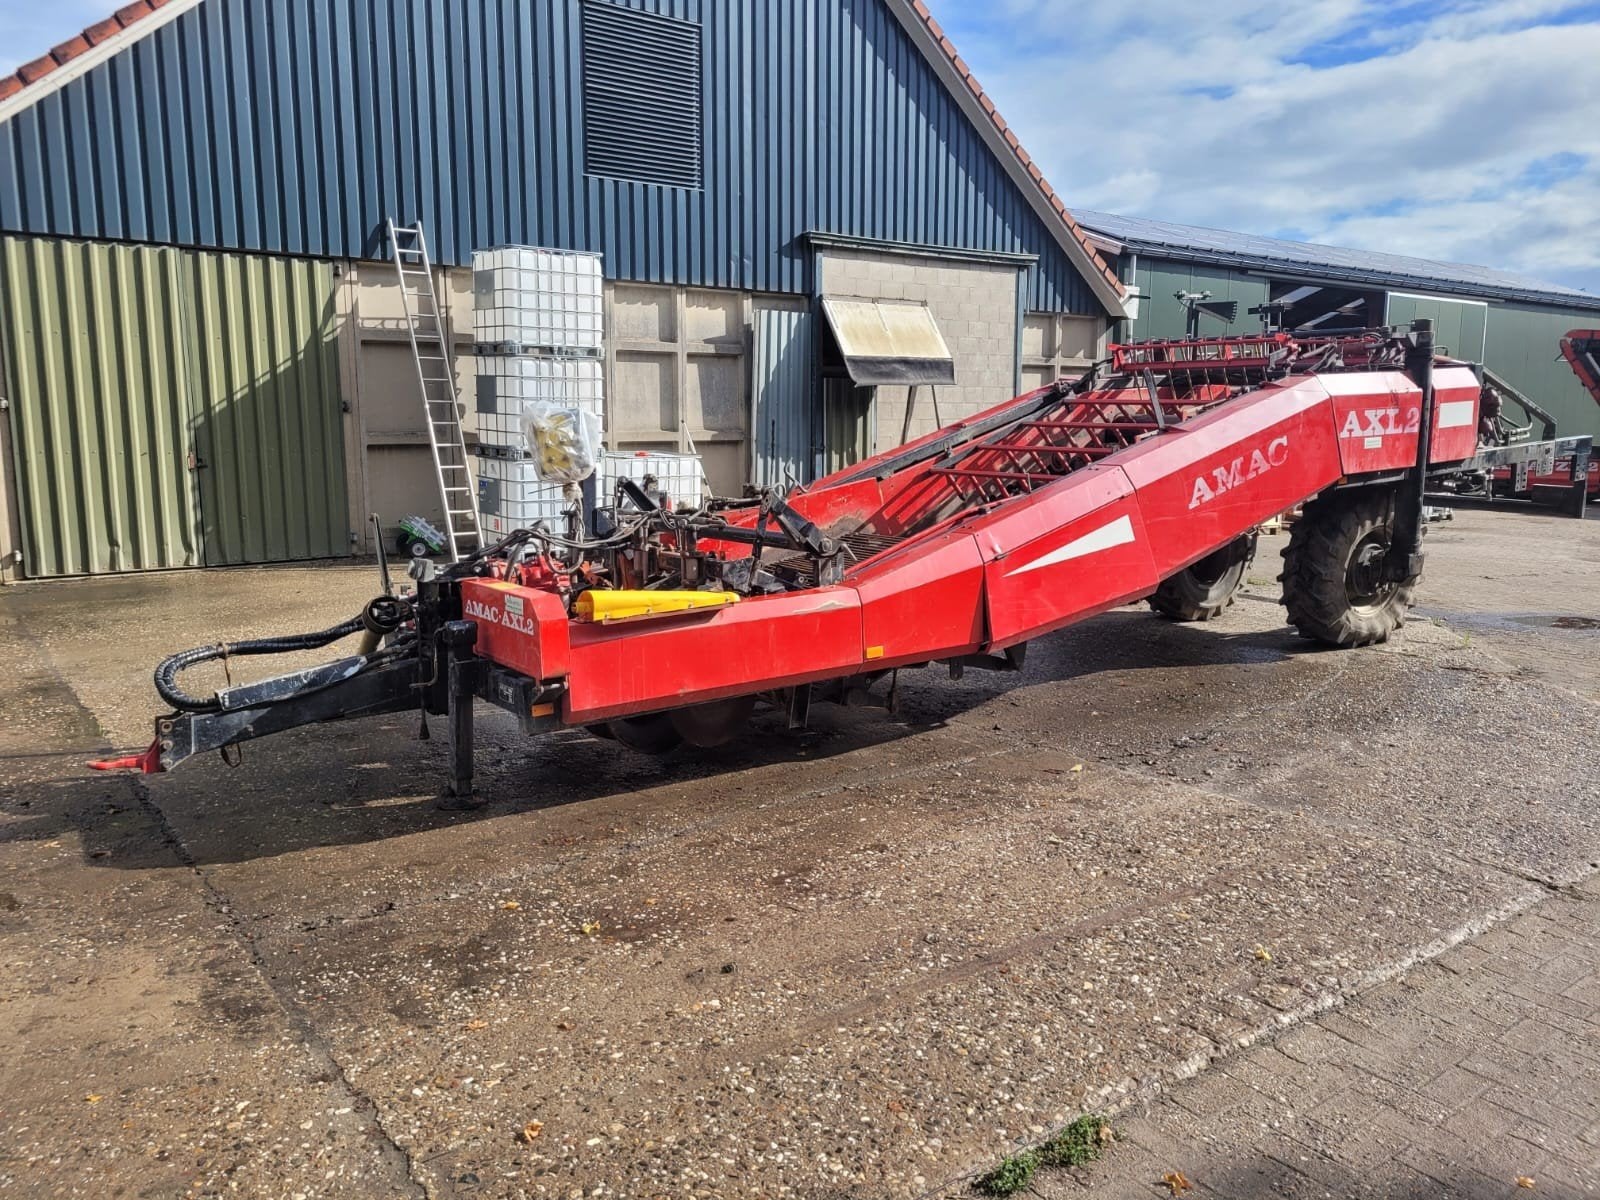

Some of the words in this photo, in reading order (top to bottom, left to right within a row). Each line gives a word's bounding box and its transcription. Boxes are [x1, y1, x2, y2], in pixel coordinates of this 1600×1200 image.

[1340, 407, 1419, 438] AXL2
[1189, 436, 1288, 510] AMAC
[465, 599, 498, 622] AMAC
[502, 611, 534, 635] AXL2
